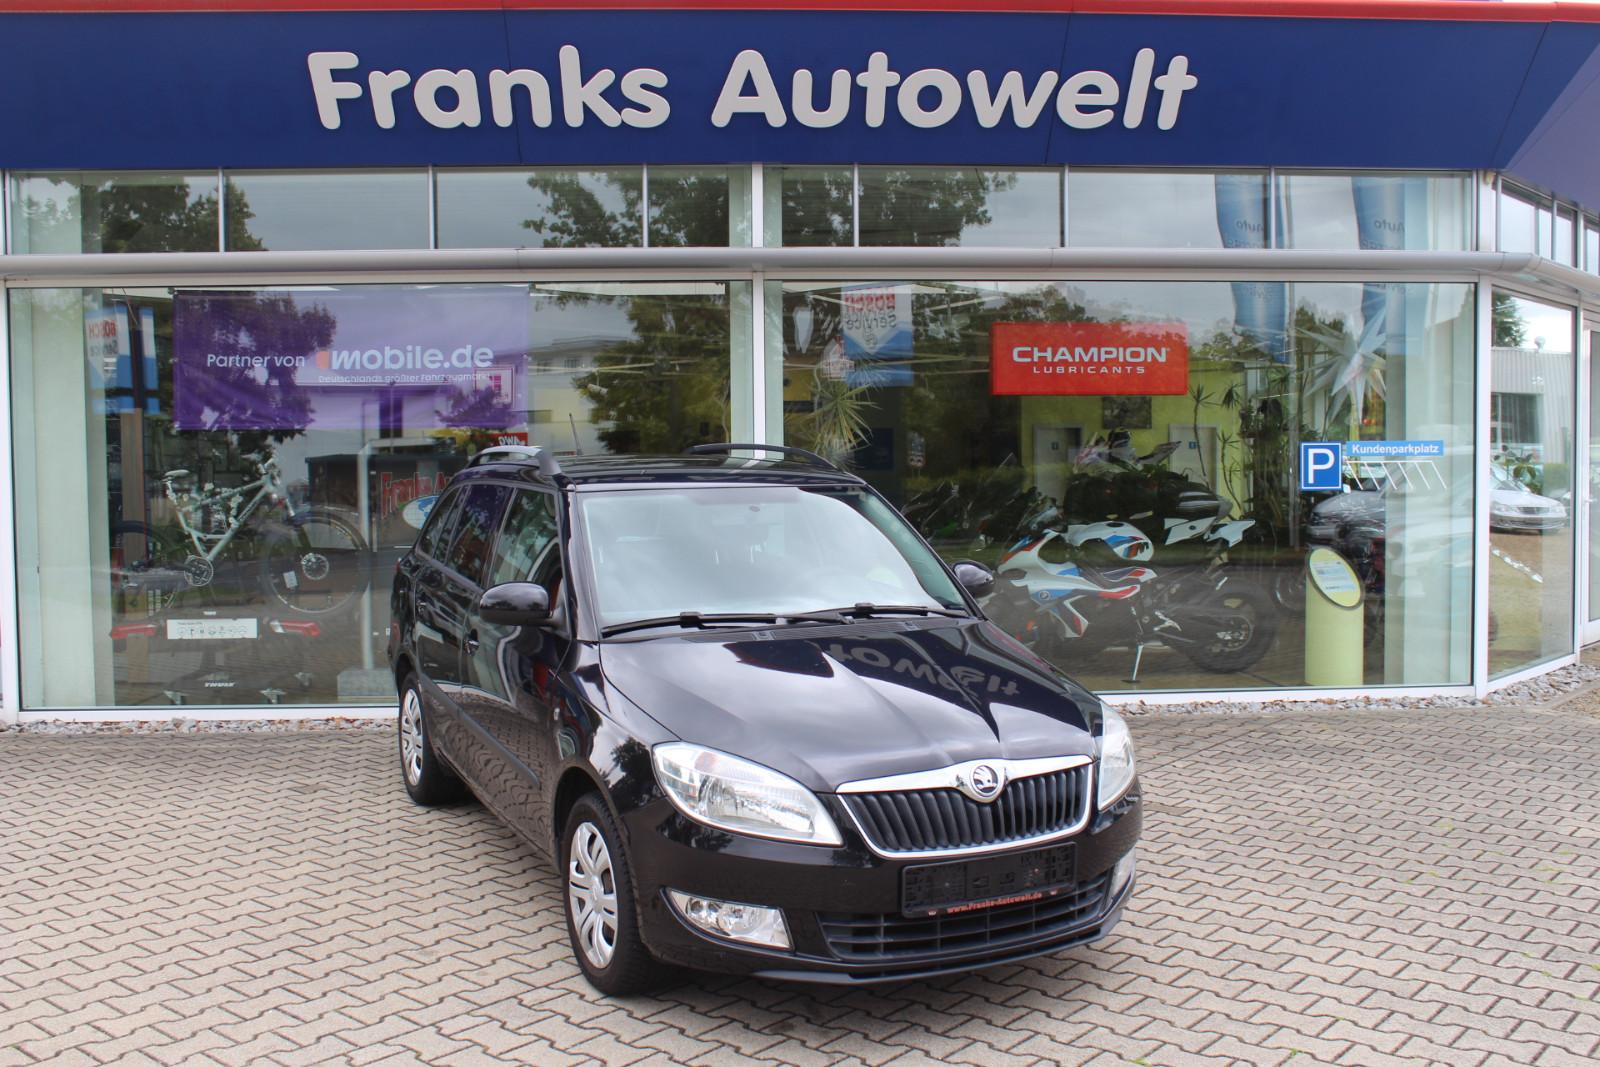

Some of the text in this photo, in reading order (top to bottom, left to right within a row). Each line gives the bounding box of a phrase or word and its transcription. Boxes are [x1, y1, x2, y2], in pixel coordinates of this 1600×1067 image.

[307, 44, 1199, 130] Franks Autowelt
[207, 345, 494, 369] Partner von mobile.de
[1012, 347, 1167, 363] CHAMPION
[1033, 366, 1145, 374] LUBRICANTS
[1352, 443, 1440, 456] Kundenparkplatz
[1307, 448, 1335, 484] P
